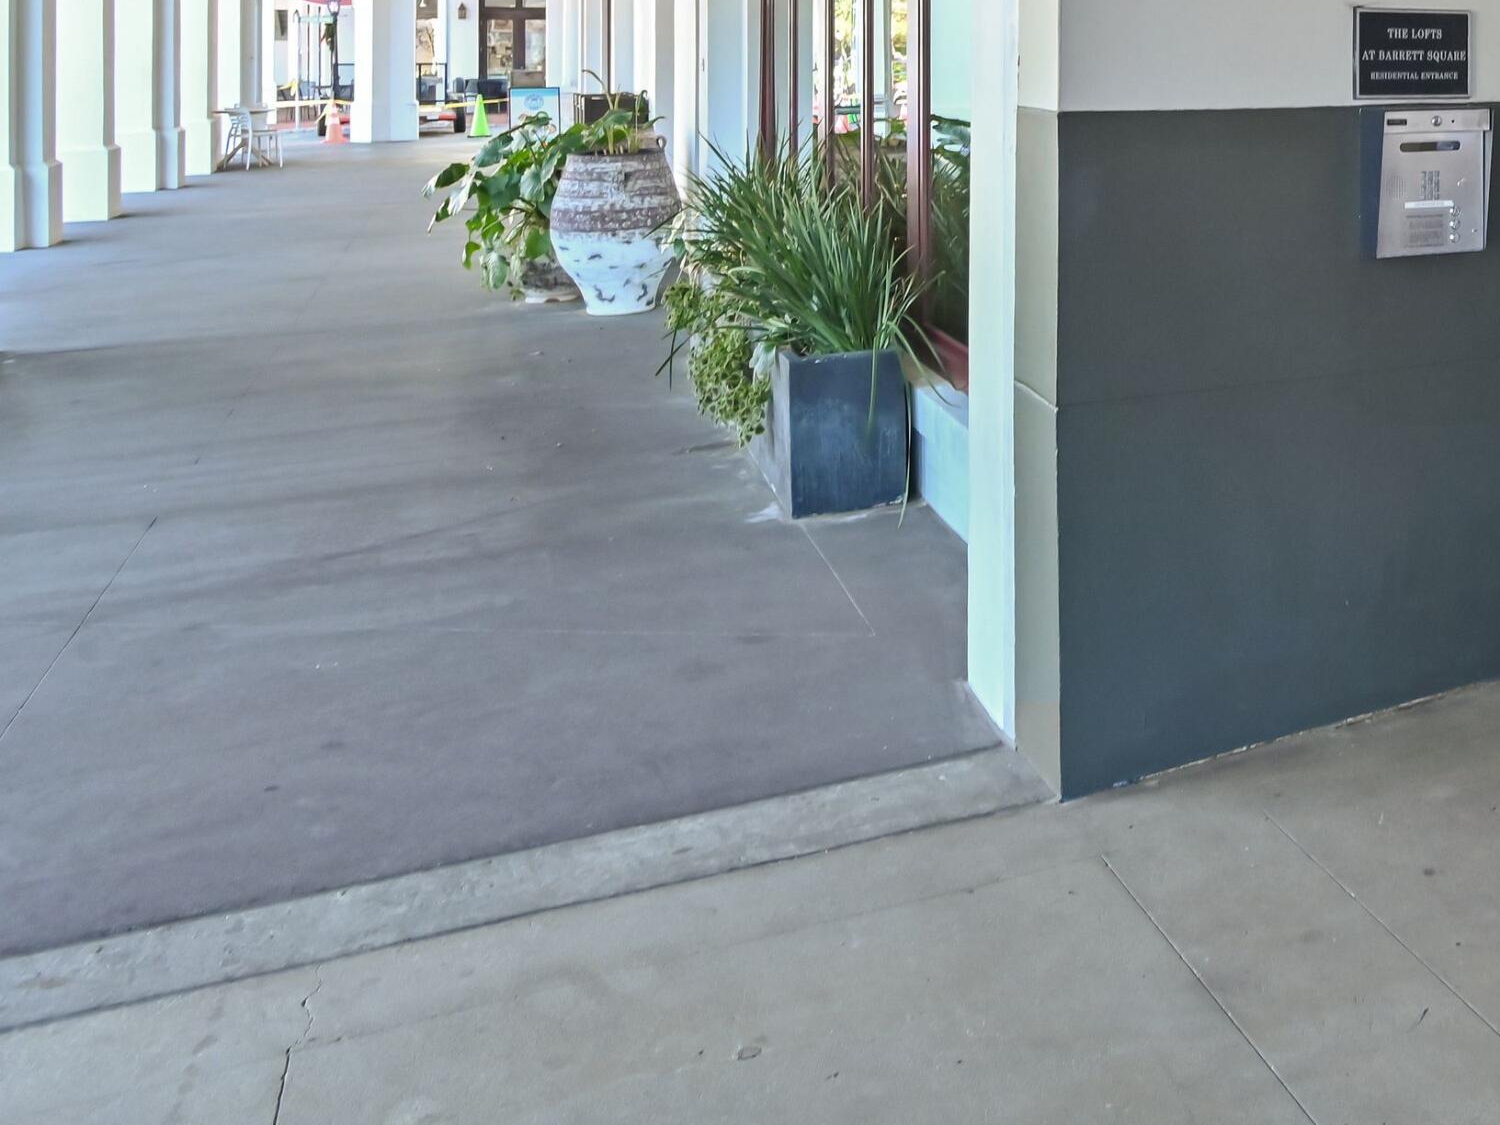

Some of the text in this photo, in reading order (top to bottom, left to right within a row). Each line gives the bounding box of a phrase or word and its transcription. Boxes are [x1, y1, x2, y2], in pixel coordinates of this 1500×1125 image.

[1387, 28, 1442, 40] THE LOFTS
[1362, 50, 1467, 63] AT BARRETT SQUARE
[1370, 71, 1459, 80] RESIDENTIAL ENTRANCE
